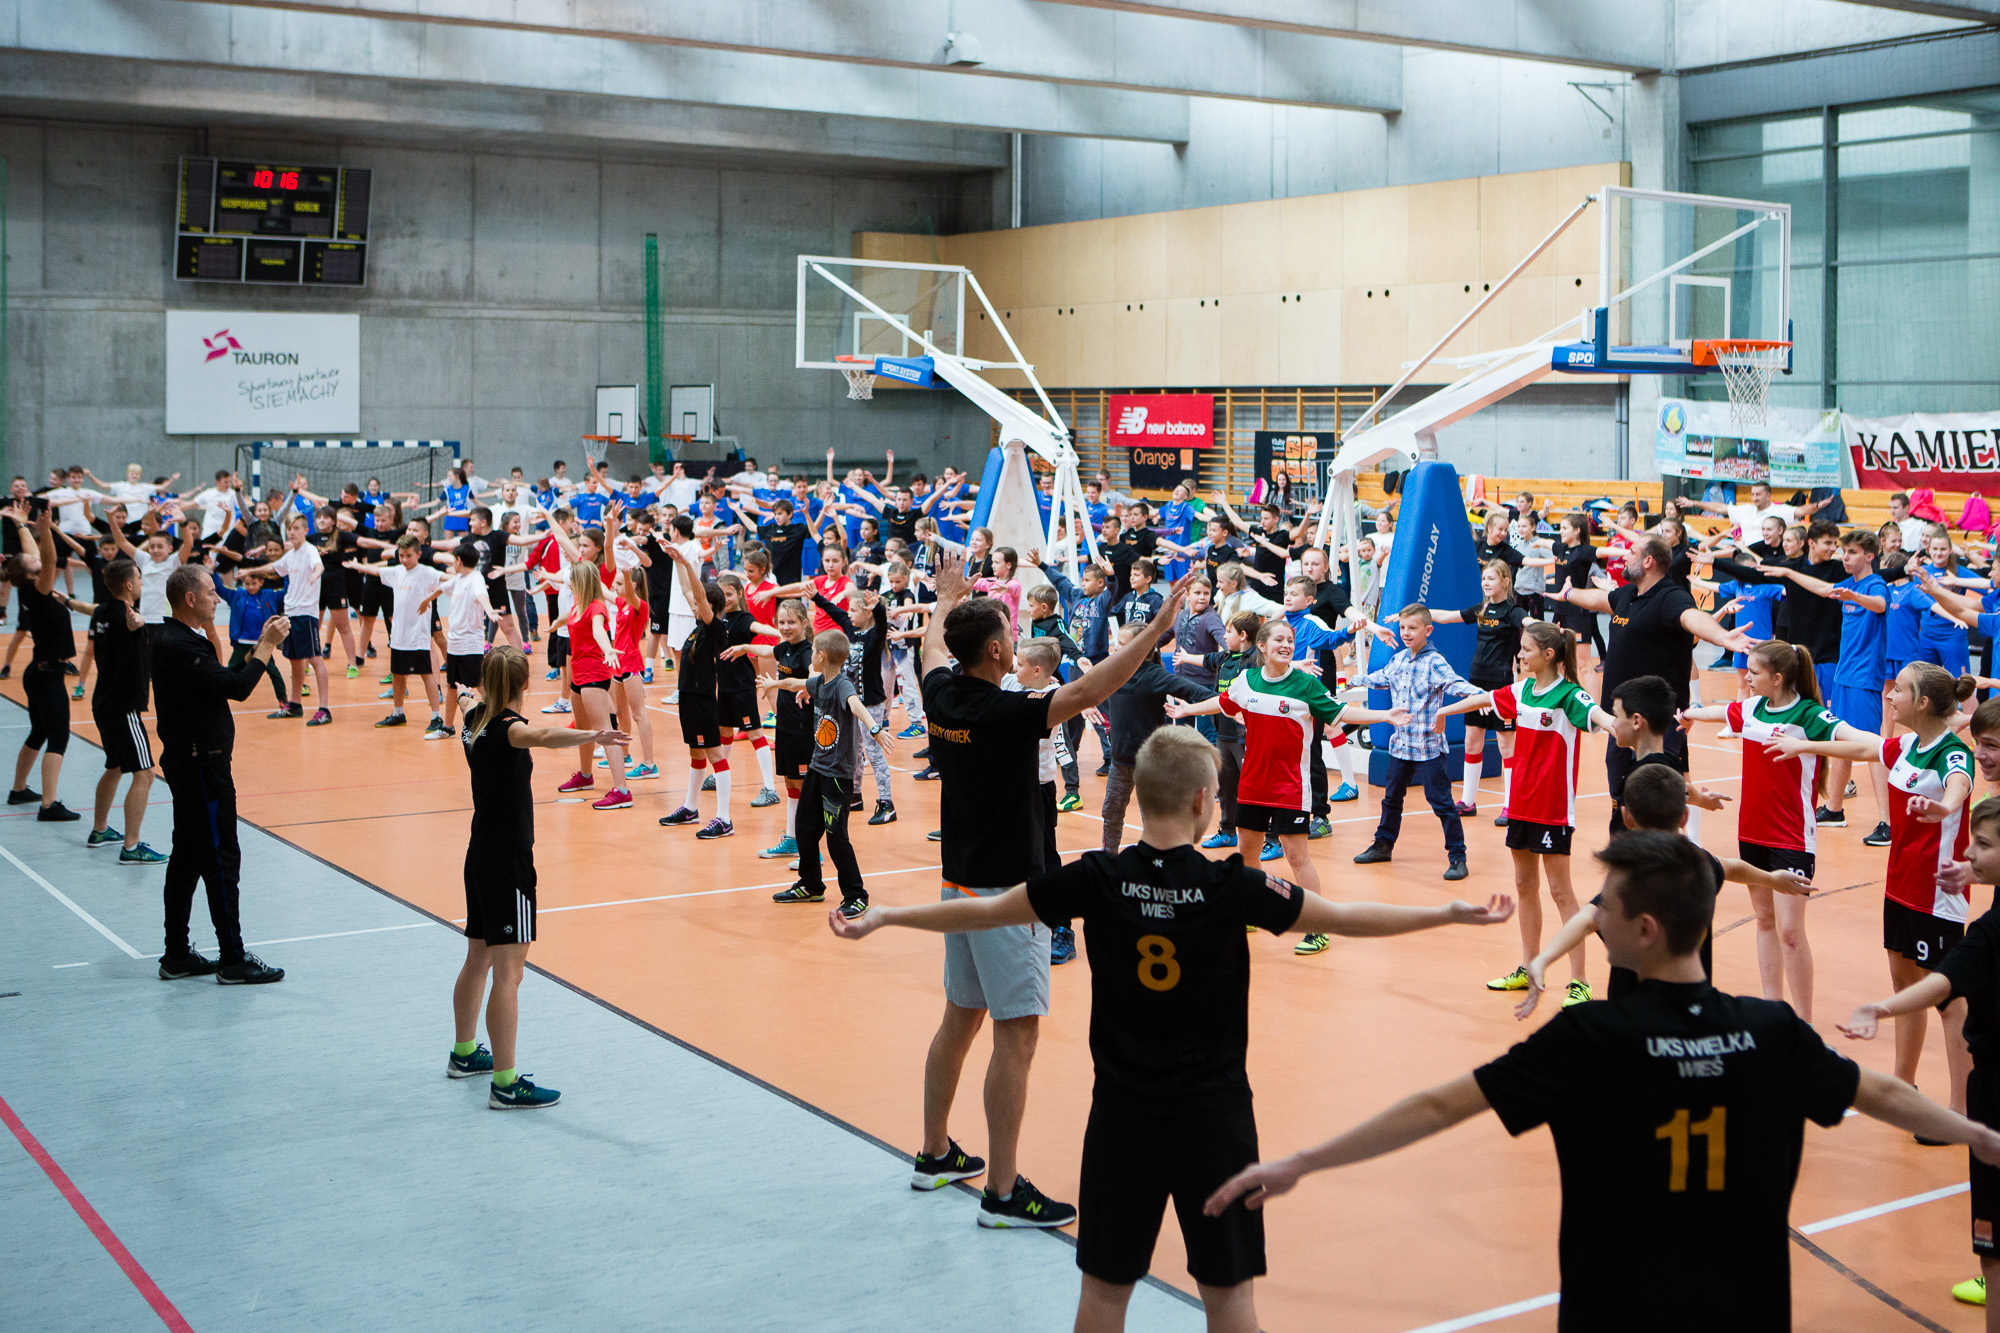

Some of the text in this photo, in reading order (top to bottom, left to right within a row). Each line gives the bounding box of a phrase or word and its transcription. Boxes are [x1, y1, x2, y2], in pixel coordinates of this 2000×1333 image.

[254, 170, 299, 190] 10 16
[233, 352, 299, 365] TAURON
[1568, 352, 1595, 363] SPO
[253, 381, 339, 410] SIEMACHY
[1147, 423, 1165, 434] new
[1166, 420, 1205, 435] balance
[1134, 448, 1176, 470] Orange
[1417, 522, 1440, 603] YDROPLAY
[1480, 619, 1499, 627] ange
[1541, 830, 1553, 849] 4
[1121, 881, 1151, 900] UKS
[1916, 940, 1929, 961] 9
[1136, 934, 1181, 992] 8
[1646, 1030, 1757, 1057] UKS WIELKA
[1655, 1106, 1727, 1192] 11
